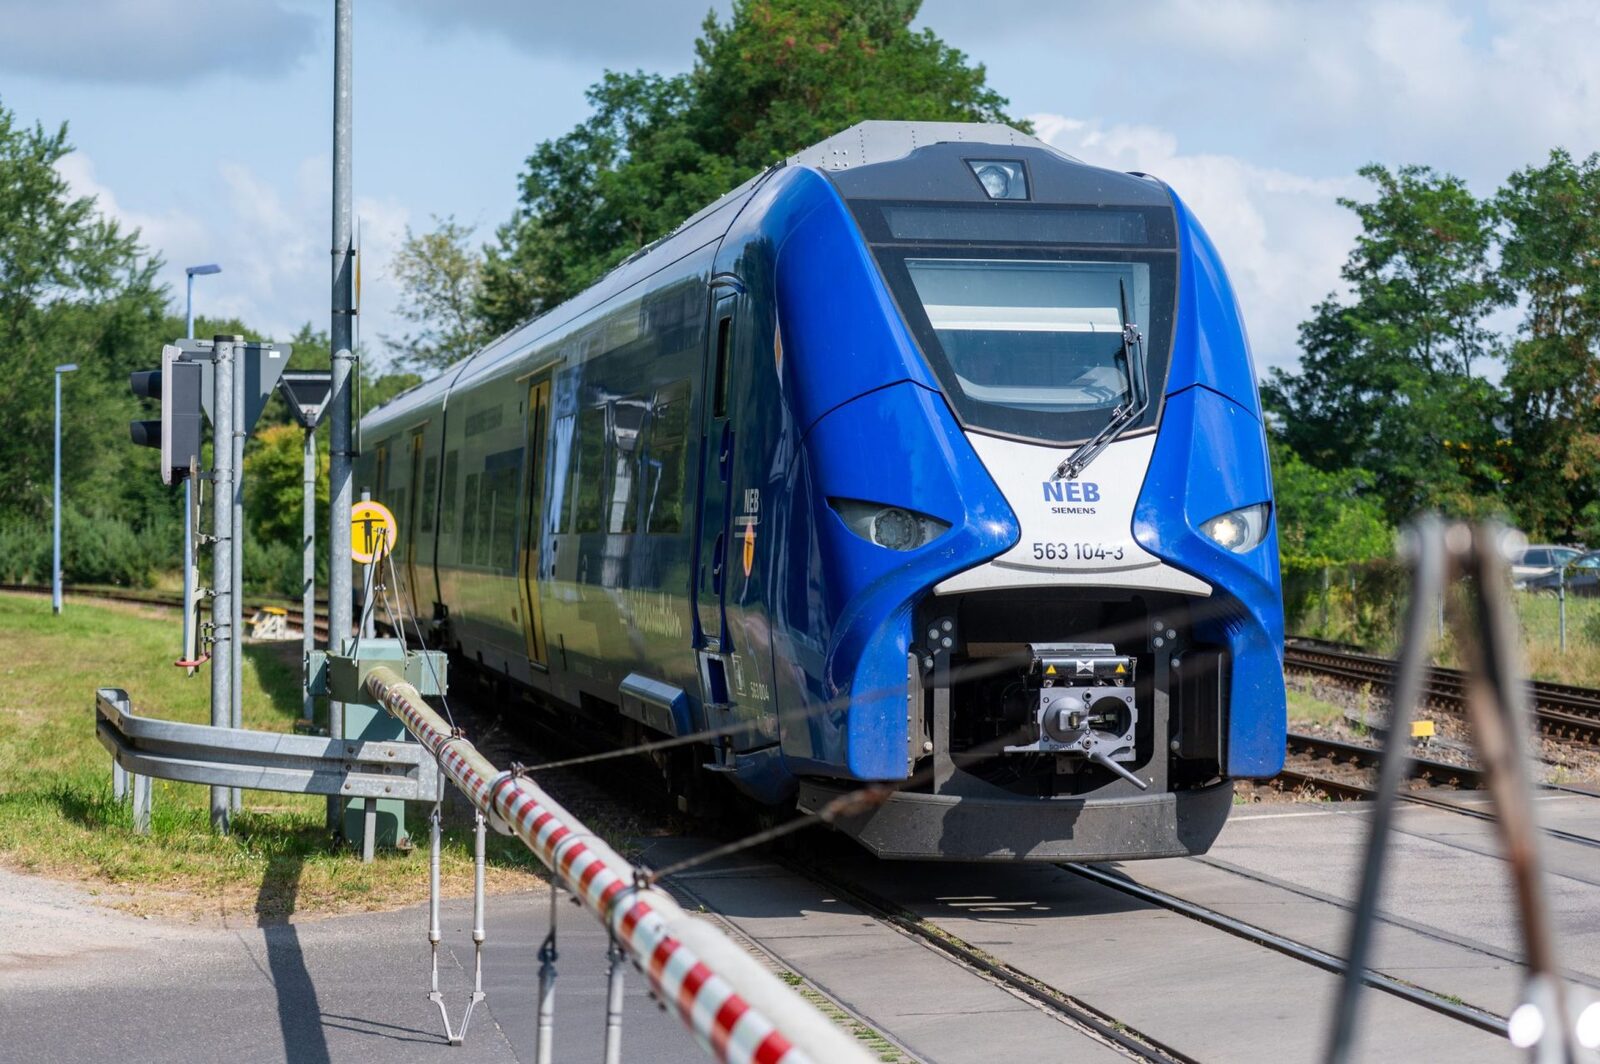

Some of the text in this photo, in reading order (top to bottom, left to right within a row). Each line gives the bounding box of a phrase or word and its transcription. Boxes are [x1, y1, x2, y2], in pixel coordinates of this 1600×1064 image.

[744, 488, 759, 513] NEB
[1042, 482, 1101, 502] NEB
[1051, 507, 1096, 515] SIEMENS
[1033, 543, 1124, 560] 563 104-3
